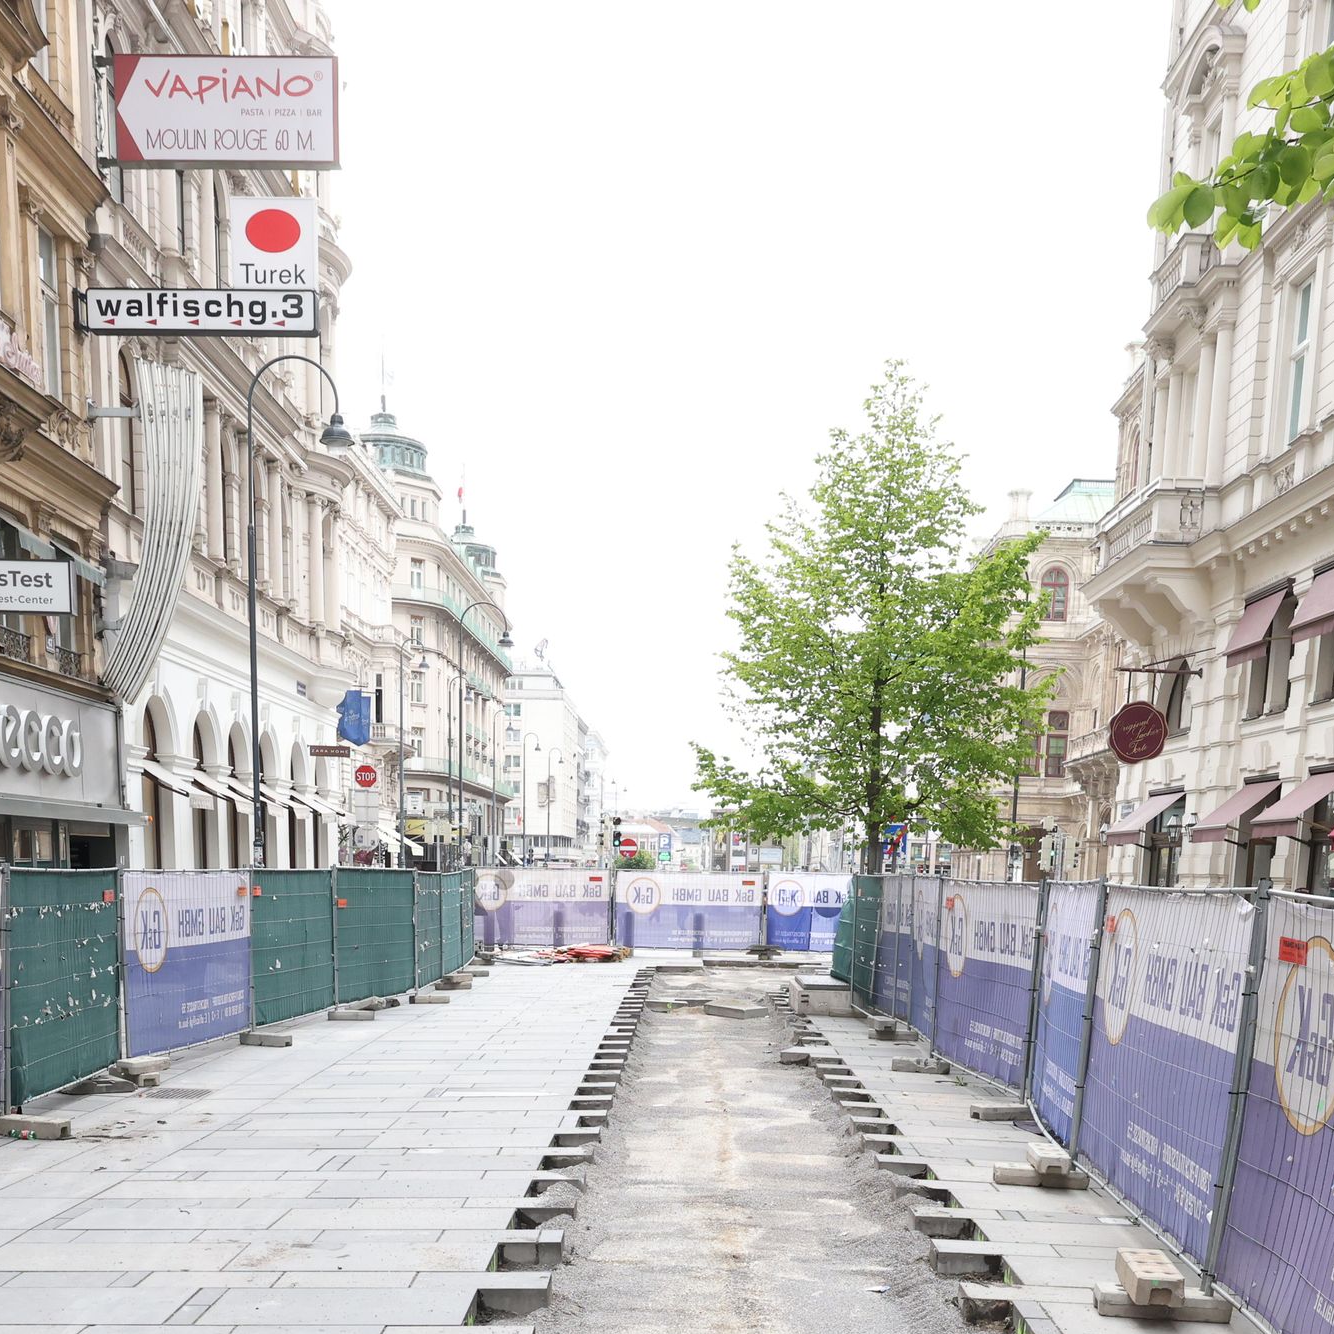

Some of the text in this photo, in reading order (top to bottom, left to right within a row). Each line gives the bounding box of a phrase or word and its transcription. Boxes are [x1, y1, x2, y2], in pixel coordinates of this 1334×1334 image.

[241, 109, 322, 117] PASTA PIZZA BAR
[146, 129, 315, 151] MOULIN ROUGE 60 M.
[240, 263, 306, 284] Turek
[96, 293, 304, 325] walfischg.3
[356, 771, 376, 781] STOP
